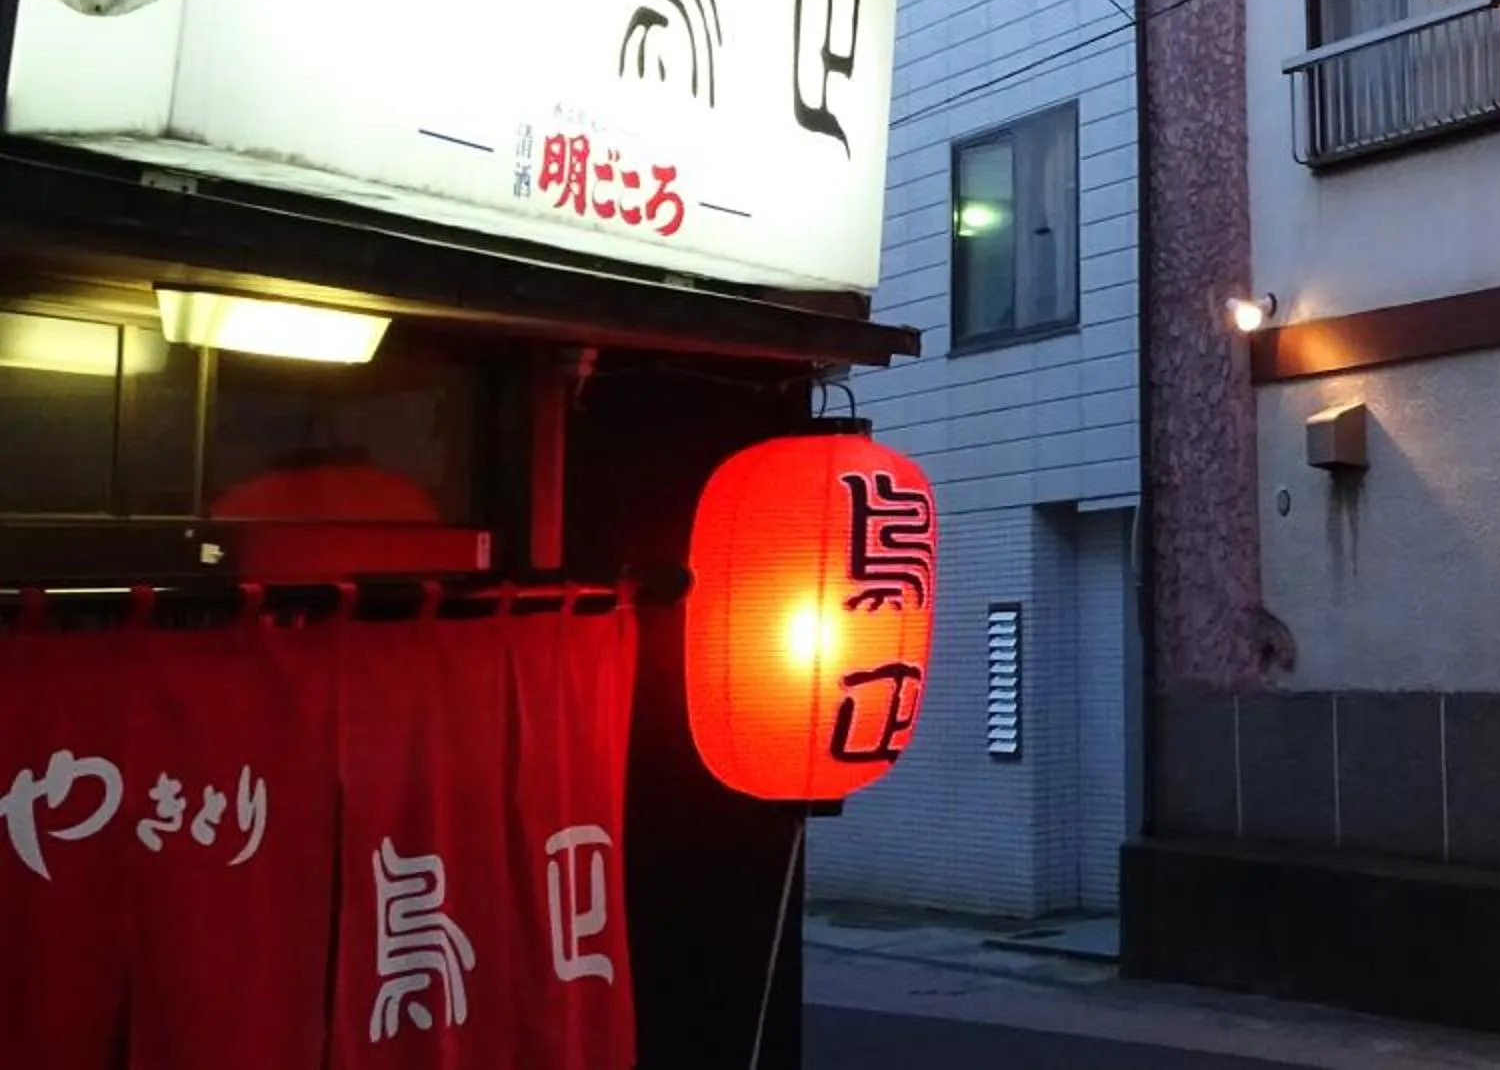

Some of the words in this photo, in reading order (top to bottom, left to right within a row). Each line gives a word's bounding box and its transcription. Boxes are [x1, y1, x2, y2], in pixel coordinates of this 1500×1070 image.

[538, 133, 686, 236] 明ごころ
[0, 749, 267, 881] やきとり
